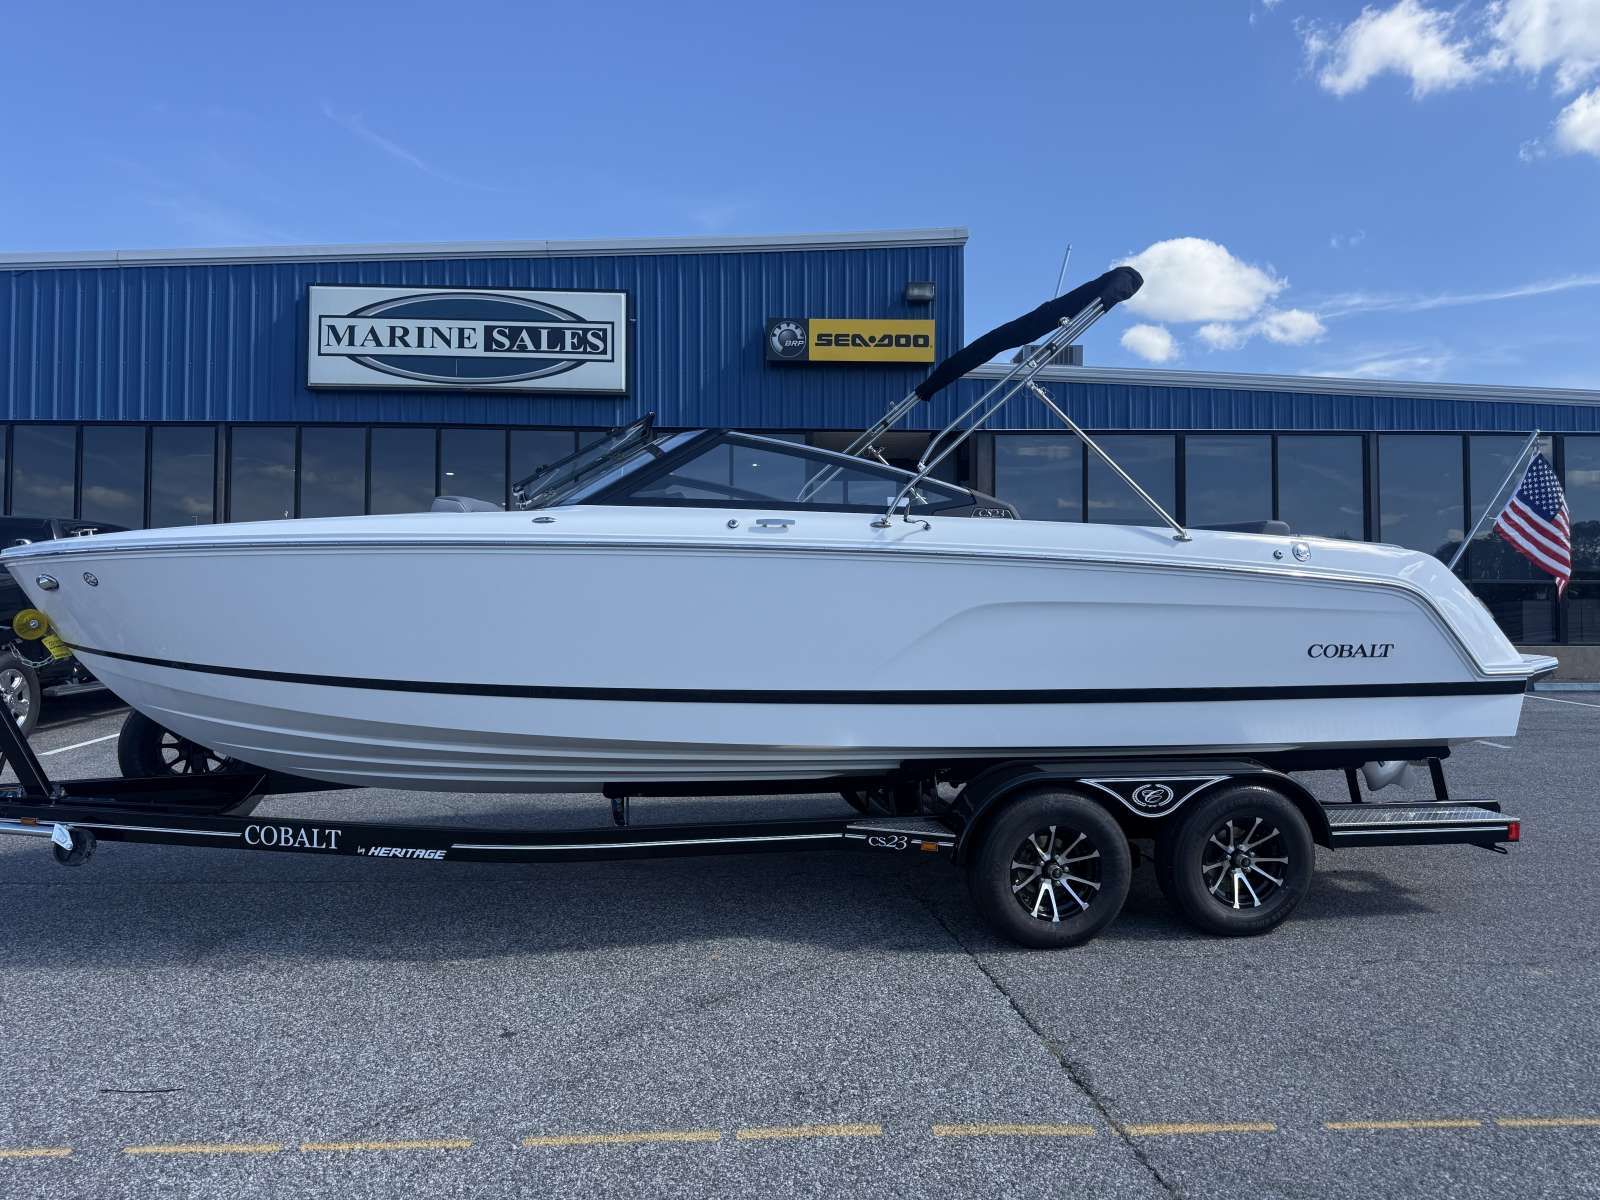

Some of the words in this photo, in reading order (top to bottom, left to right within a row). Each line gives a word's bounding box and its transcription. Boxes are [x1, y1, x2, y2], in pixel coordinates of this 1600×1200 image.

[323, 324, 478, 350] MARINE
[491, 326, 605, 354] SALES
[1307, 643, 1395, 659] COBALT
[244, 824, 342, 849] COBALT
[367, 846, 448, 860] HERITAGE
